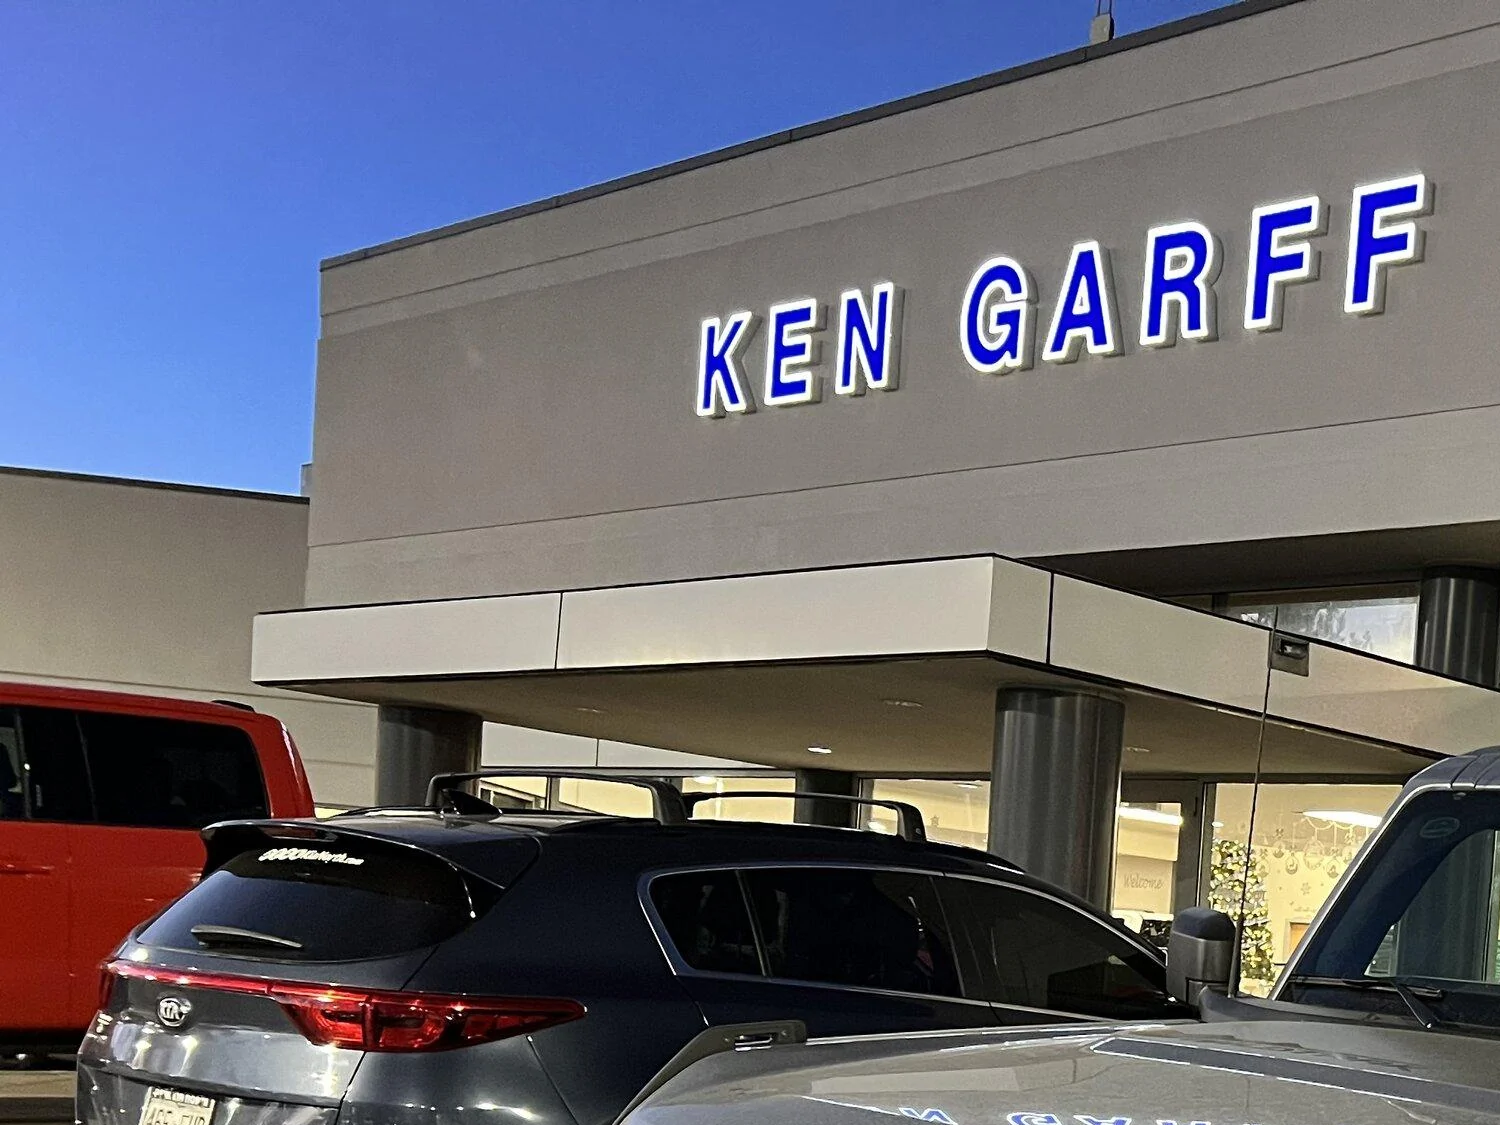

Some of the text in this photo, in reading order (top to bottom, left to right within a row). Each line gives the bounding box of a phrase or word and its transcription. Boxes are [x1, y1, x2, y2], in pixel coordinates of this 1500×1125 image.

[696, 173, 1430, 417] KEN GARFF
[1123, 873, 1164, 890] Welcome
